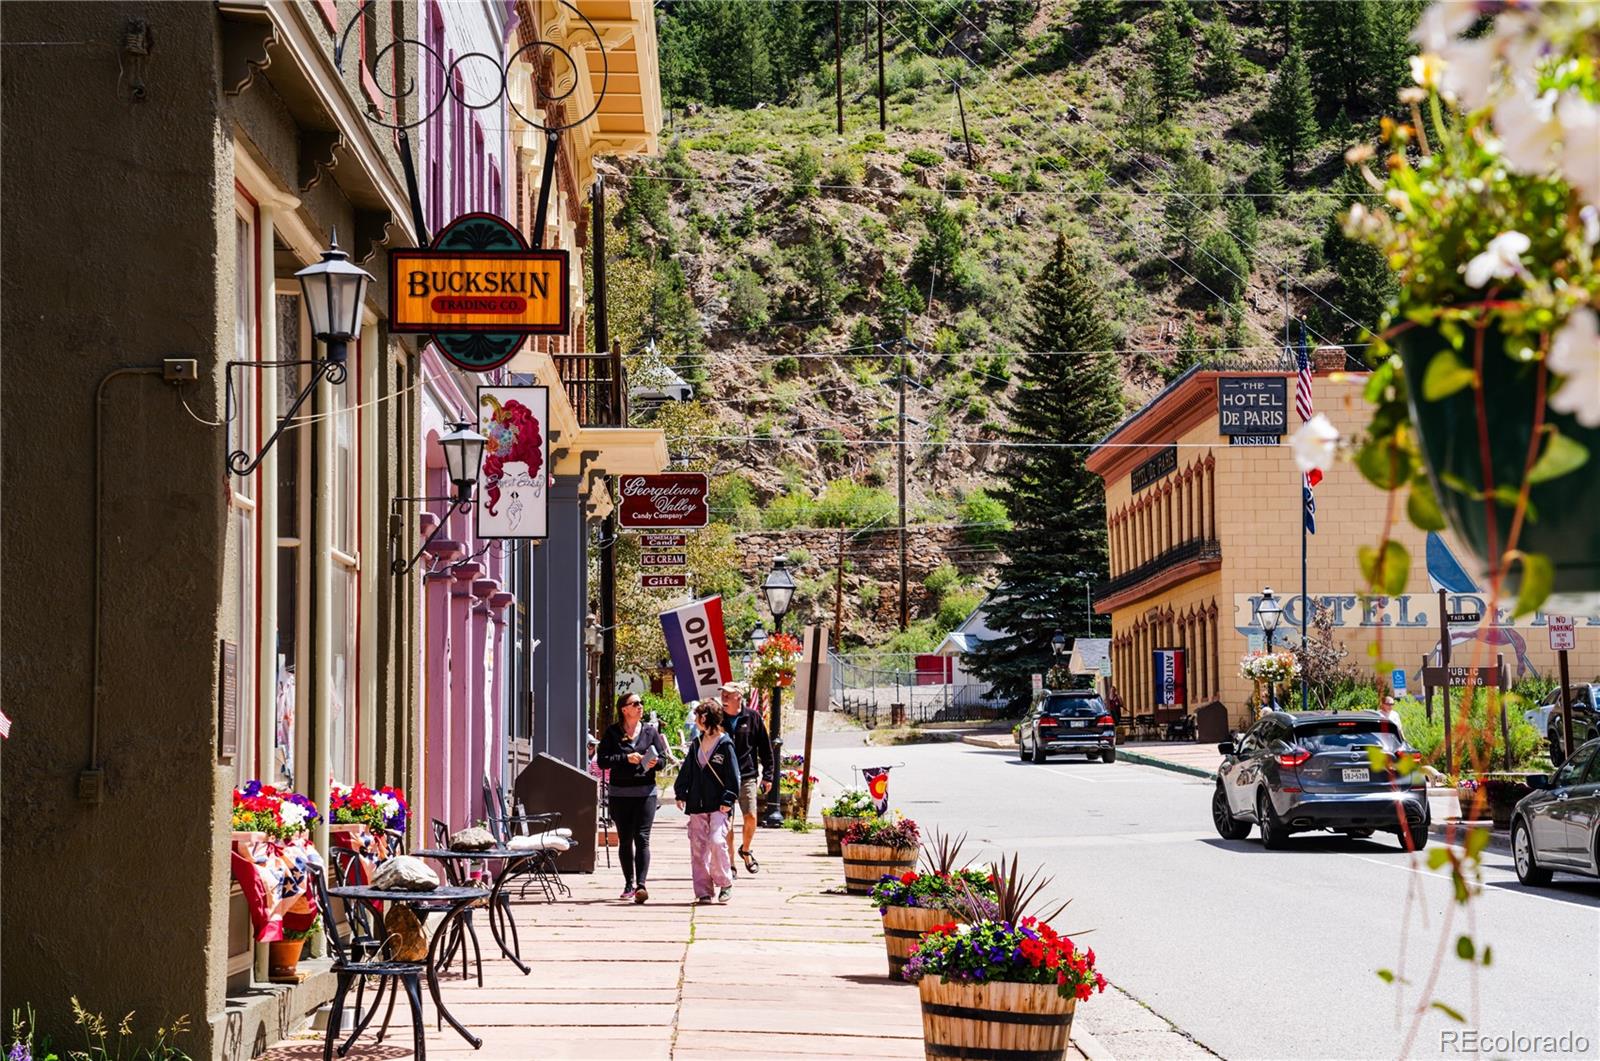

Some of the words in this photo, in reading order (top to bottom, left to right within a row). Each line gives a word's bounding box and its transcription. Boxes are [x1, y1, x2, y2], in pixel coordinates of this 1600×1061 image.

[408, 271, 549, 299] BUCKSKIN
[440, 300, 497, 311] TRADING
[500, 300, 521, 311] CO.
[1241, 382, 1265, 390] THE
[1222, 394, 1283, 406] HOTEL
[1222, 410, 1240, 426] DE
[1243, 410, 1284, 426] PARIS
[1233, 435, 1279, 446] MUSEUM
[623, 477, 701, 502] Georgetown
[655, 496, 697, 516] Valley
[632, 512, 652, 520] Candy
[653, 512, 683, 520] Company
[643, 555, 655, 564] ICE
[657, 555, 684, 564] CREAM
[648, 577, 679, 585] Gifts
[1555, 616, 1566, 624] NO
[685, 617, 718, 686] OPEN
[1166, 655, 1174, 701] ANTIQUES
[1448, 668, 1479, 677] UBLIC
[1449, 678, 1483, 686] ARKING
